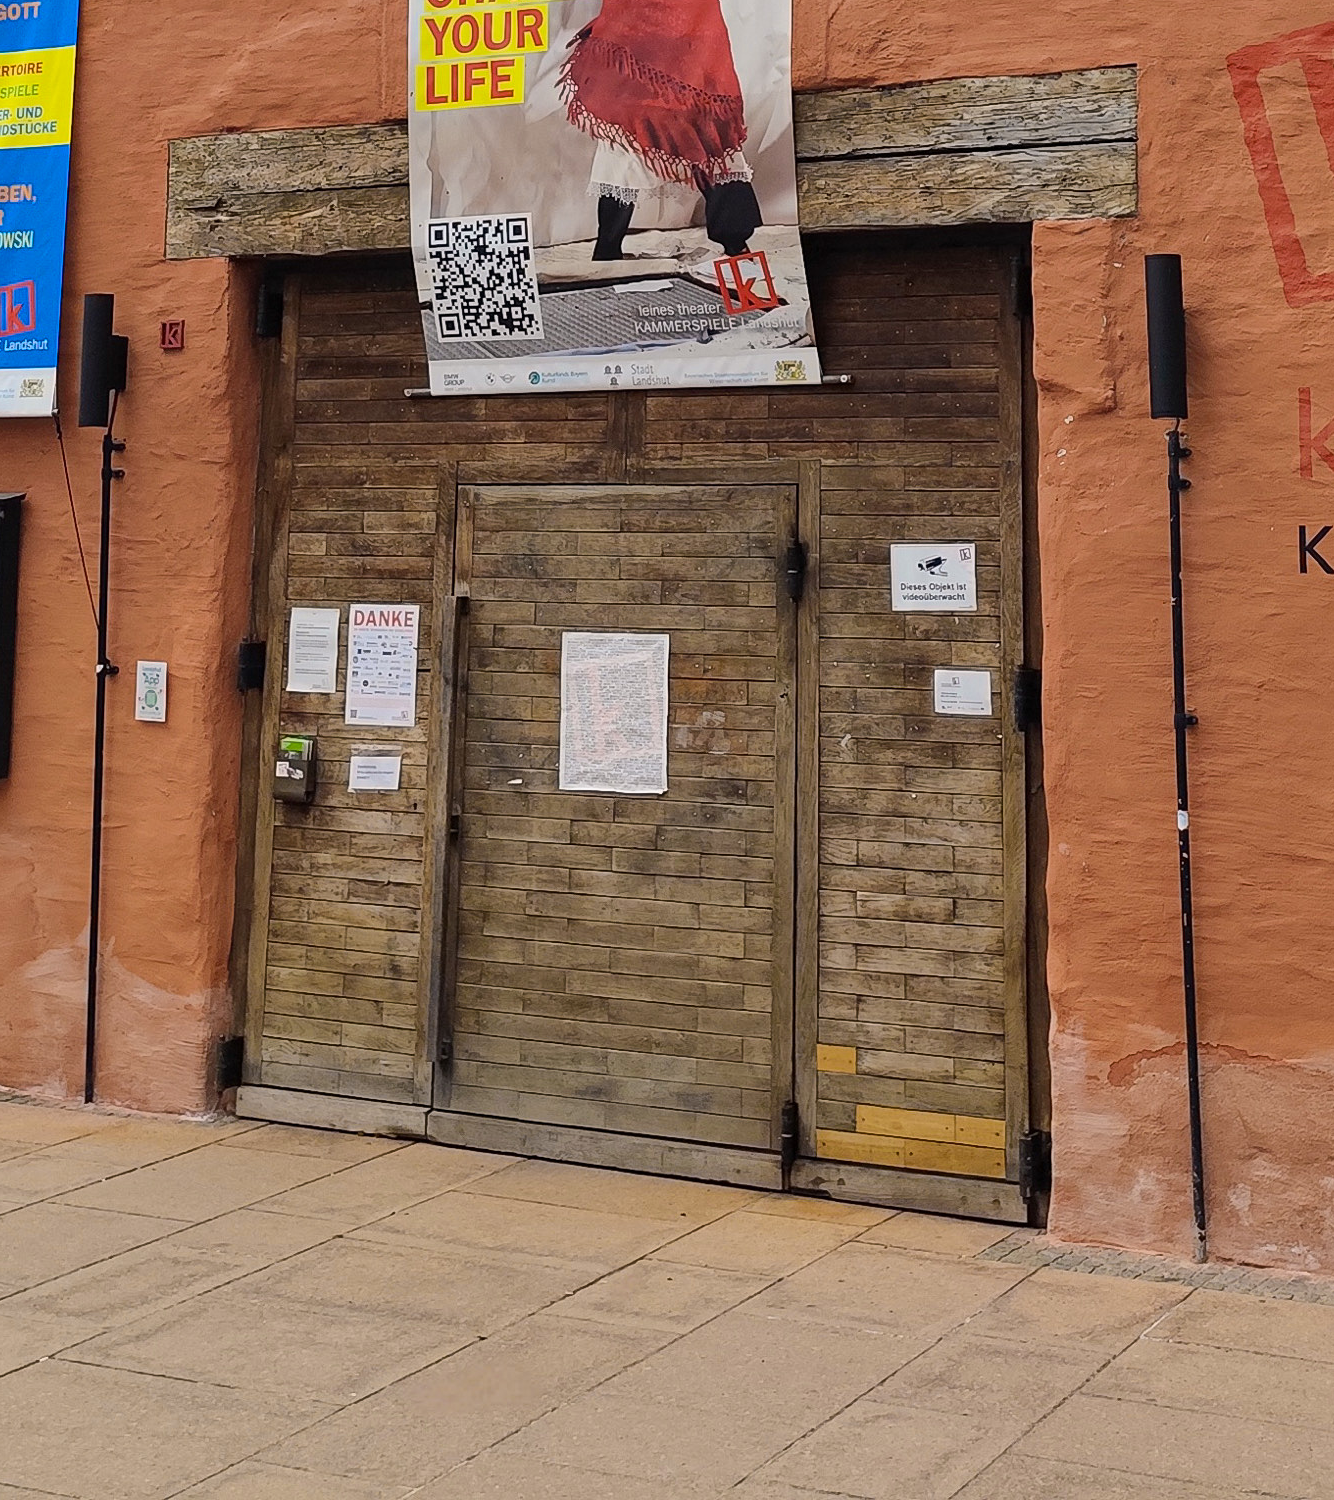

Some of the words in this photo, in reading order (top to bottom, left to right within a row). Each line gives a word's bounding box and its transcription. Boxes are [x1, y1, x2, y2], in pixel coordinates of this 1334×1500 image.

[424, 8, 543, 56] YOUR
[426, 59, 516, 104] LIFE
[16, 106, 43, 119] UND
[677, 302, 722, 316] theater
[634, 317, 738, 334] KAMMERSPIELE
[741, 316, 800, 329] Landshut
[4, 339, 48, 351] Landshut
[630, 363, 654, 375] Stadt
[632, 375, 671, 386] Landshut
[900, 582, 927, 591] Dieses
[929, 582, 955, 592] Objekt
[902, 592, 966, 601] videoüberwacht
[353, 609, 415, 627] DANKE
